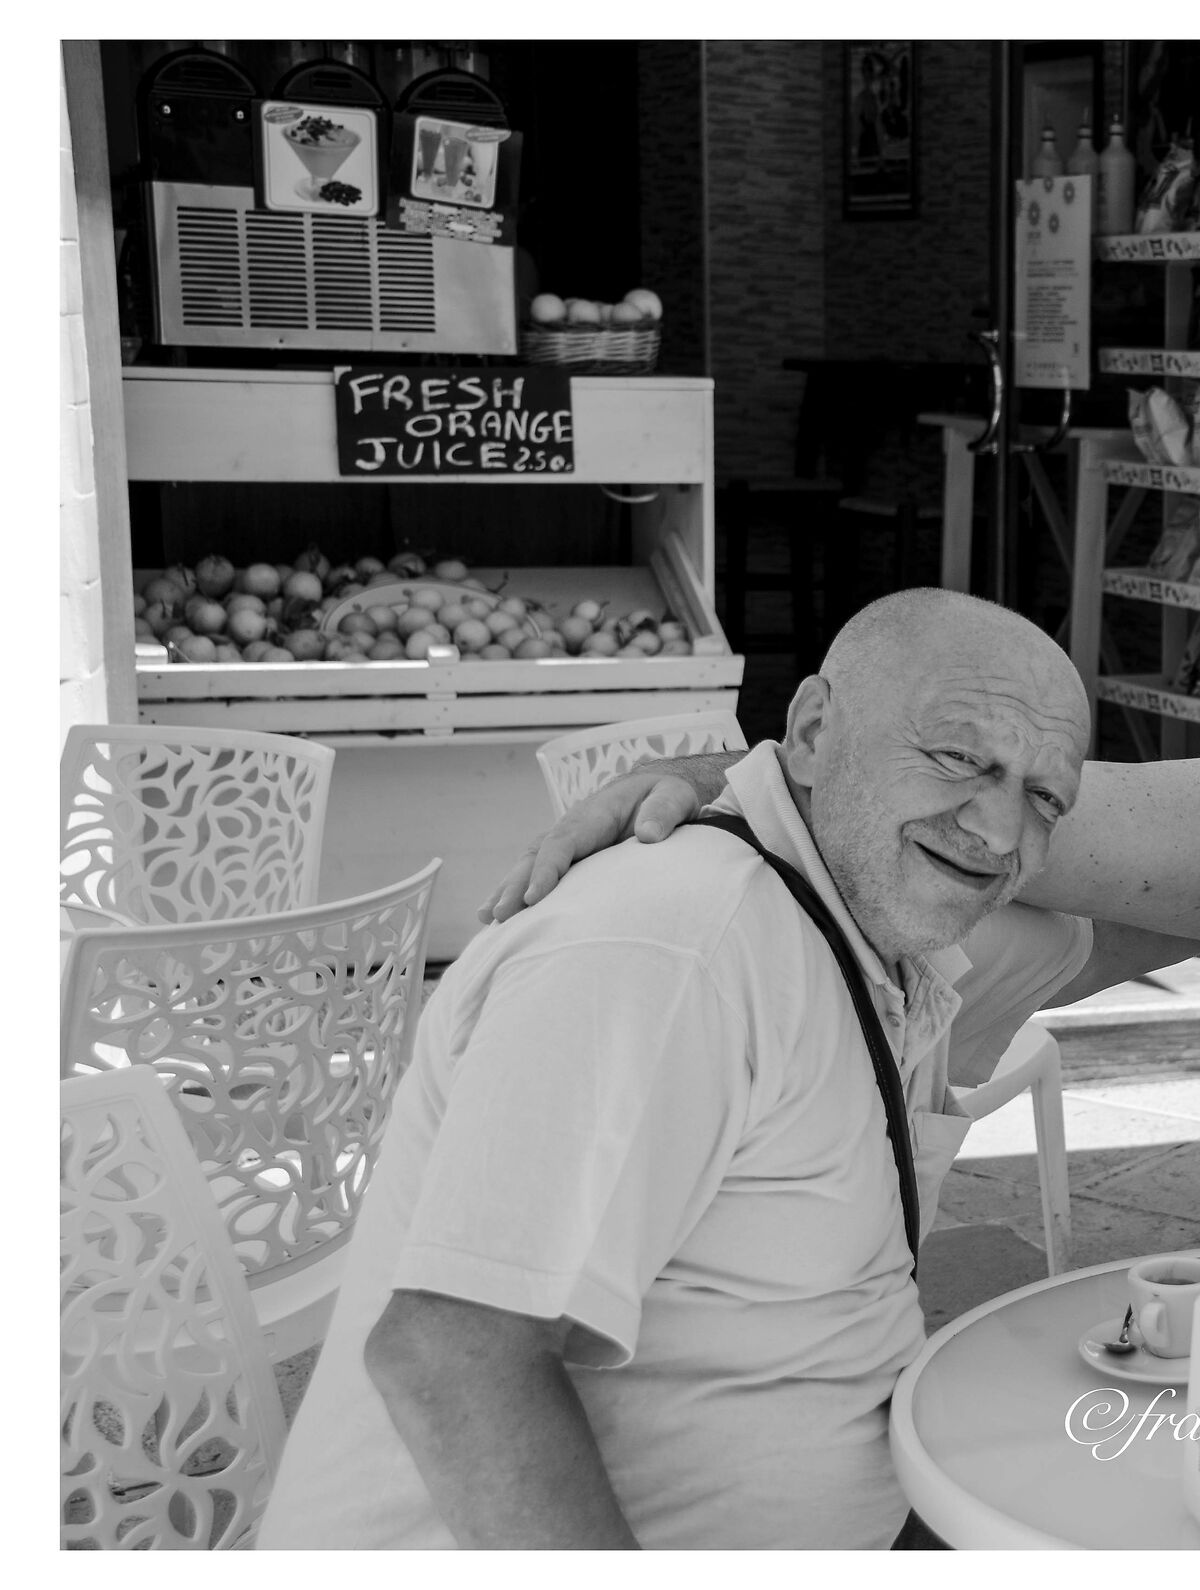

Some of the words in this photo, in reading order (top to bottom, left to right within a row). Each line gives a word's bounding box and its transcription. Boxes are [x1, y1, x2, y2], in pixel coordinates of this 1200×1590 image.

[349, 373, 525, 414] FRESH
[405, 410, 574, 443] ORANGE
[355, 437, 508, 470] JUICE
